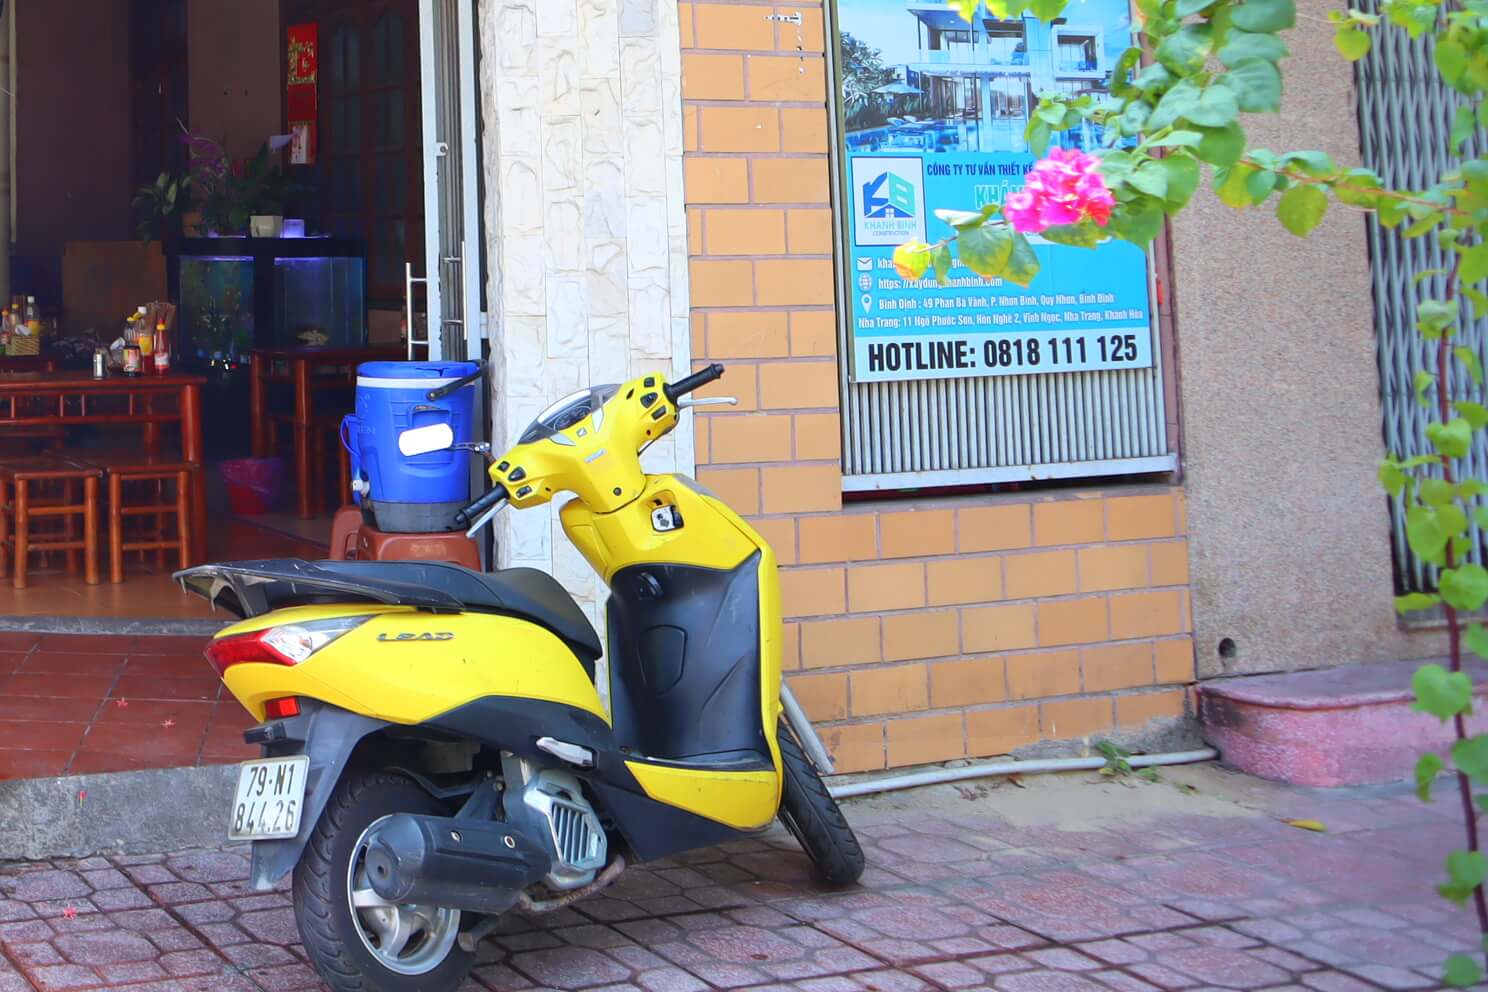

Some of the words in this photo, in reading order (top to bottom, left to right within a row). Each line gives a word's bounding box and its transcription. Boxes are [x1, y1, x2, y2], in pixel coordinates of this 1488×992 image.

[953, 164, 963, 176] TY
[868, 341, 976, 372] HOTLINE:
[983, 338, 1040, 368] 0818
[1048, 336, 1087, 364] 111
[1096, 334, 1138, 363] 125
[376, 631, 455, 642] LEAD
